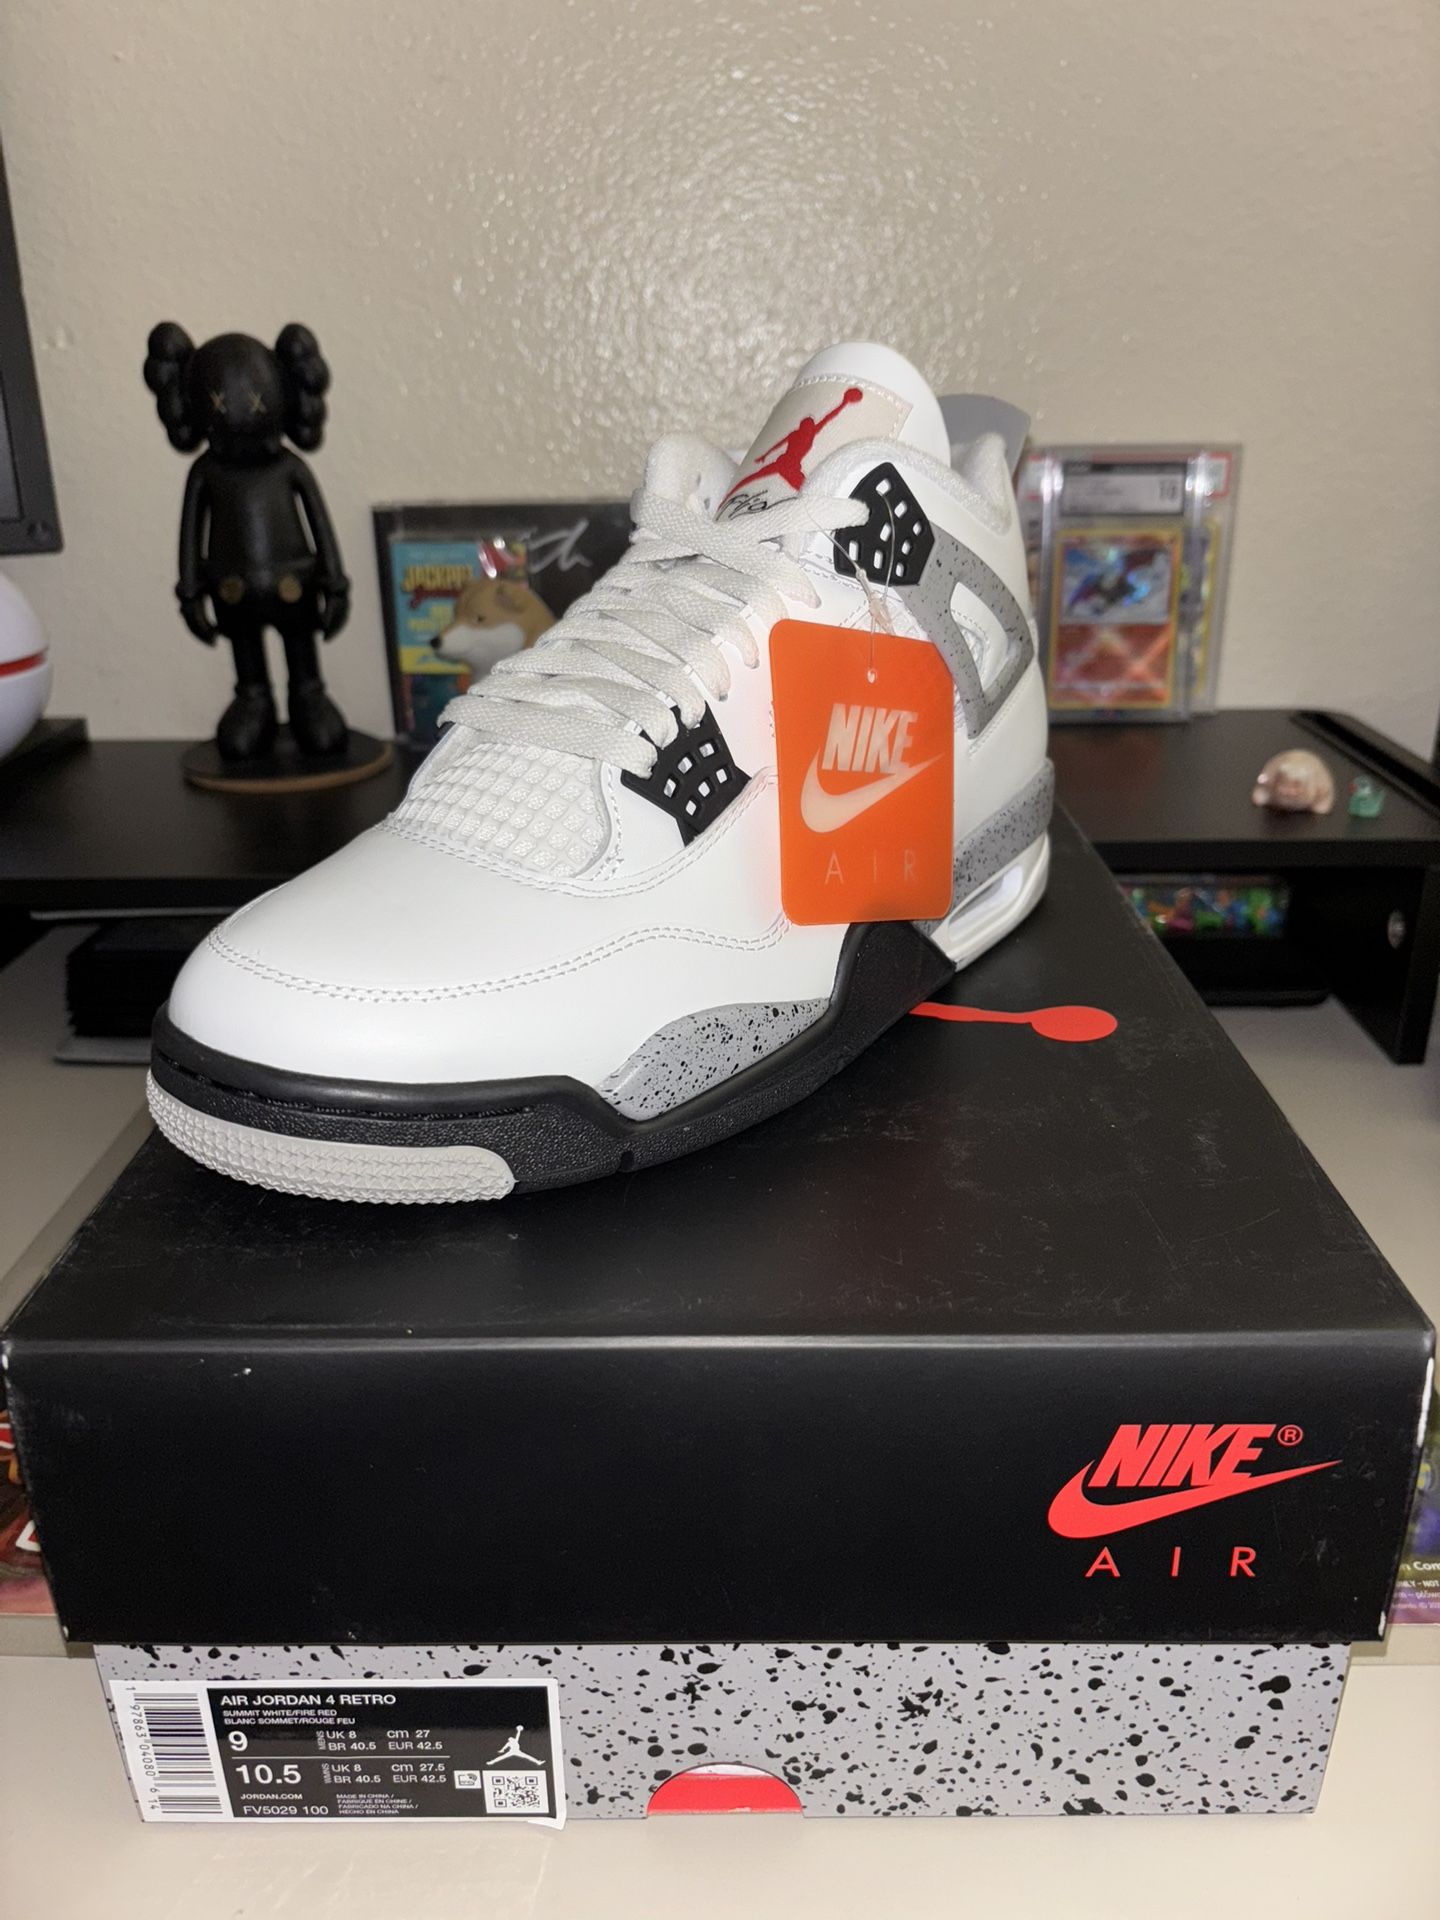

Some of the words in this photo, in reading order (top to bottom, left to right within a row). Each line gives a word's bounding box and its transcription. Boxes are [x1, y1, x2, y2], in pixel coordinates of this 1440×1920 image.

[821, 702, 919, 775] NIKE
[824, 849, 917, 885] AIR
[1087, 1424, 1277, 1488] NIKE
[1085, 1546, 1257, 1578] AIR
[220, 1694, 249, 1706] AIR
[252, 1694, 322, 1706] JORDAN
[325, 1694, 336, 1705] 4
[339, 1693, 397, 1705] RETRO
[130, 1704, 147, 1738] 97863
[222, 1709, 260, 1717] SUMMIT
[261, 1709, 316, 1717] WHITE/FIRE
[224, 1717, 256, 1725] BLANC
[257, 1717, 335, 1725] SOMMET/ROUGE
[336, 1717, 356, 1725] FEU
[228, 1730, 248, 1752] 9
[326, 1730, 346, 1739] UK
[348, 1730, 357, 1739] 8
[386, 1729, 410, 1738] cm
[415, 1729, 430, 1738] 27
[328, 1742, 346, 1751] BR
[350, 1741, 377, 1750] 40.5
[388, 1741, 414, 1750] EUR
[416, 1741, 443, 1750] 42.5
[139, 1744, 156, 1777] 04080
[331, 1764, 351, 1772] UK
[353, 1763, 362, 1772] 8
[391, 1763, 414, 1772] cm
[419, 1763, 445, 1772] 27.5
[235, 1764, 302, 1784] 10.5
[333, 1775, 352, 1784] BR
[355, 1774, 381, 1783] 40.5
[392, 1774, 418, 1783] EUR
[420, 1774, 447, 1783] 42.5
[243, 1805, 298, 1815] FV5029
[302, 1805, 329, 1815] 100
